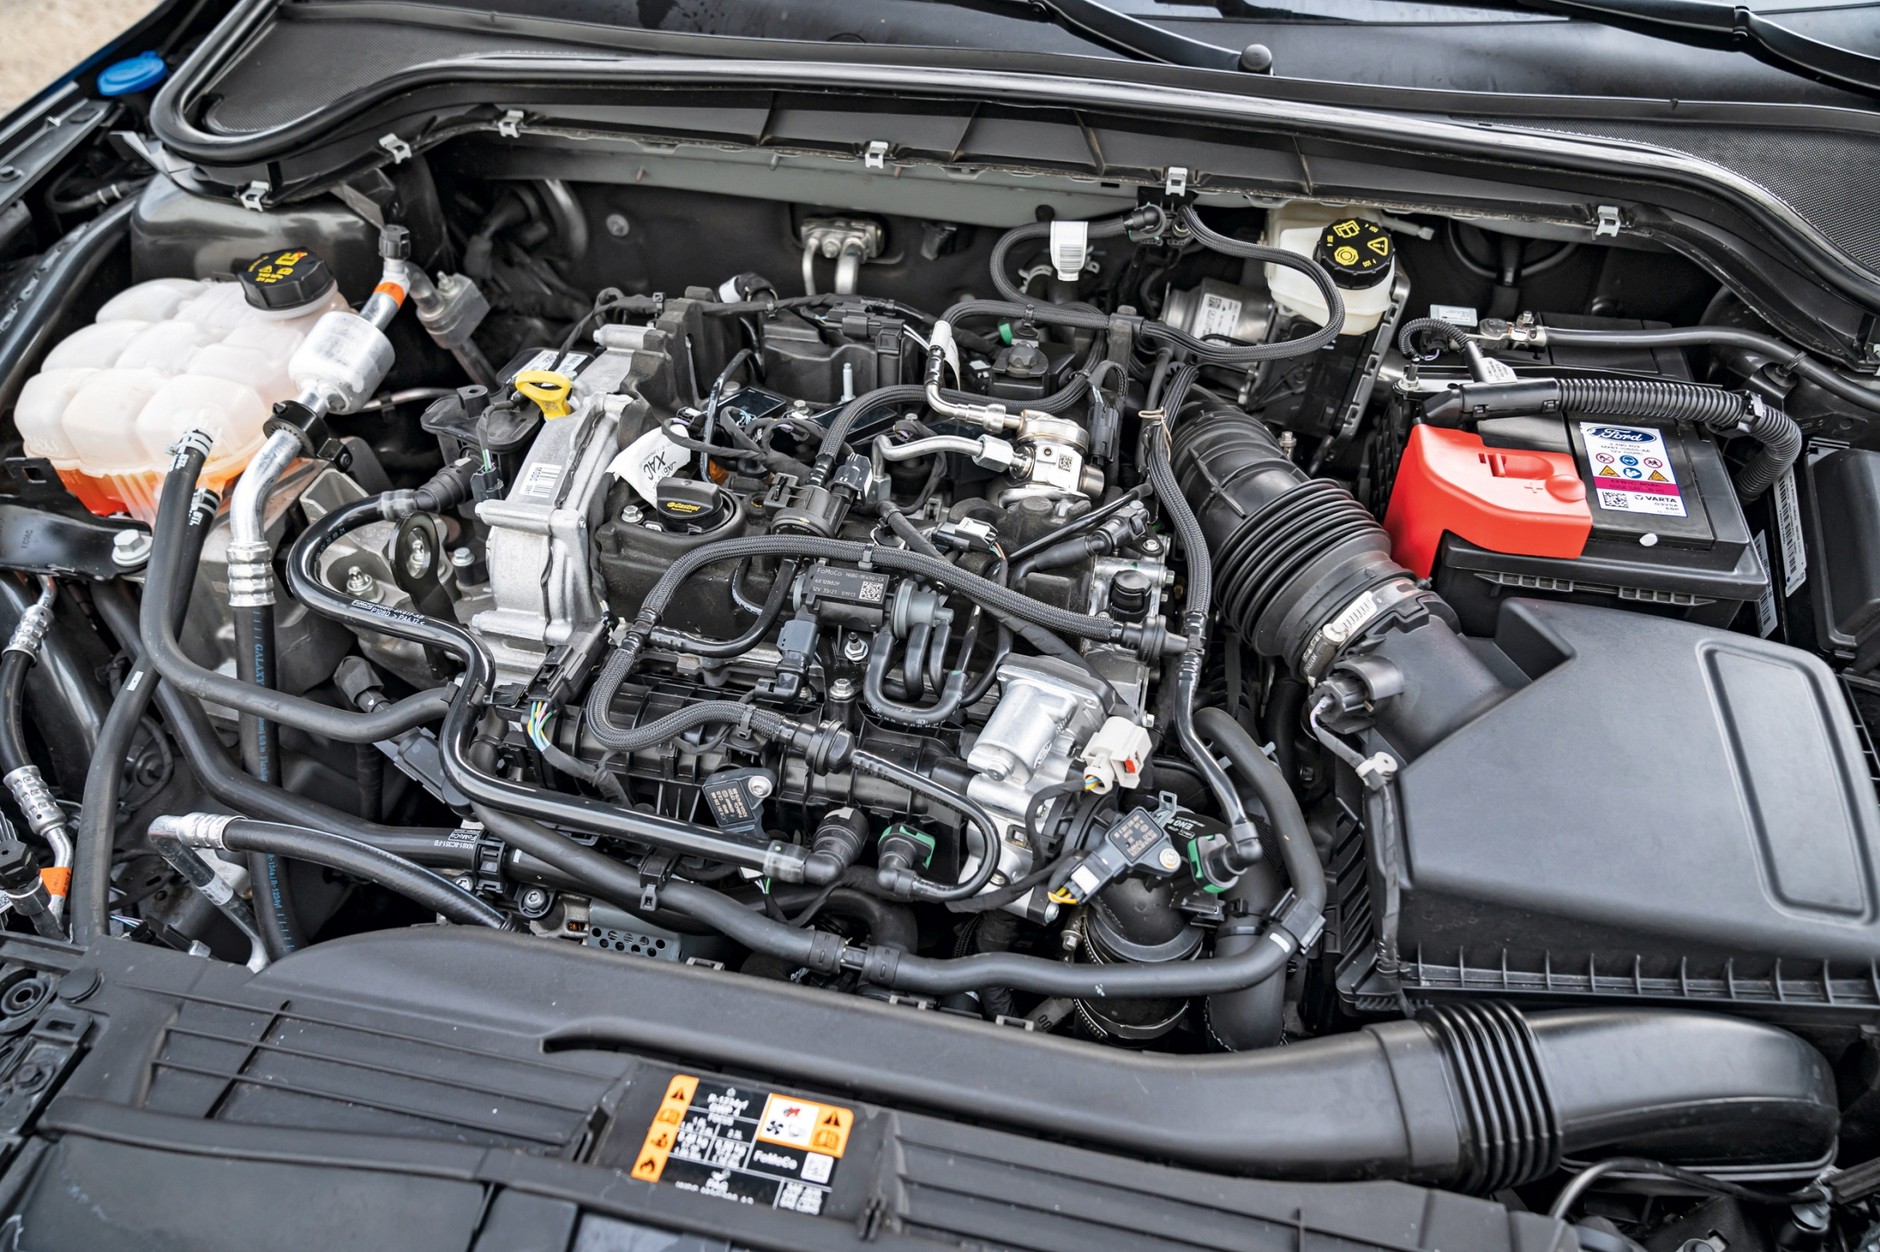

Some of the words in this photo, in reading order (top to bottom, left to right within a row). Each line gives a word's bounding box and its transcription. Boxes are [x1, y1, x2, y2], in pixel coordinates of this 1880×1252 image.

[1597, 428, 1643, 443] Ford
[1644, 495, 1678, 504] VARTA
[816, 567, 843, 578] FoMoCo
[254, 643, 265, 686] GALAXY
[752, 1149, 799, 1171] FoMoCo
